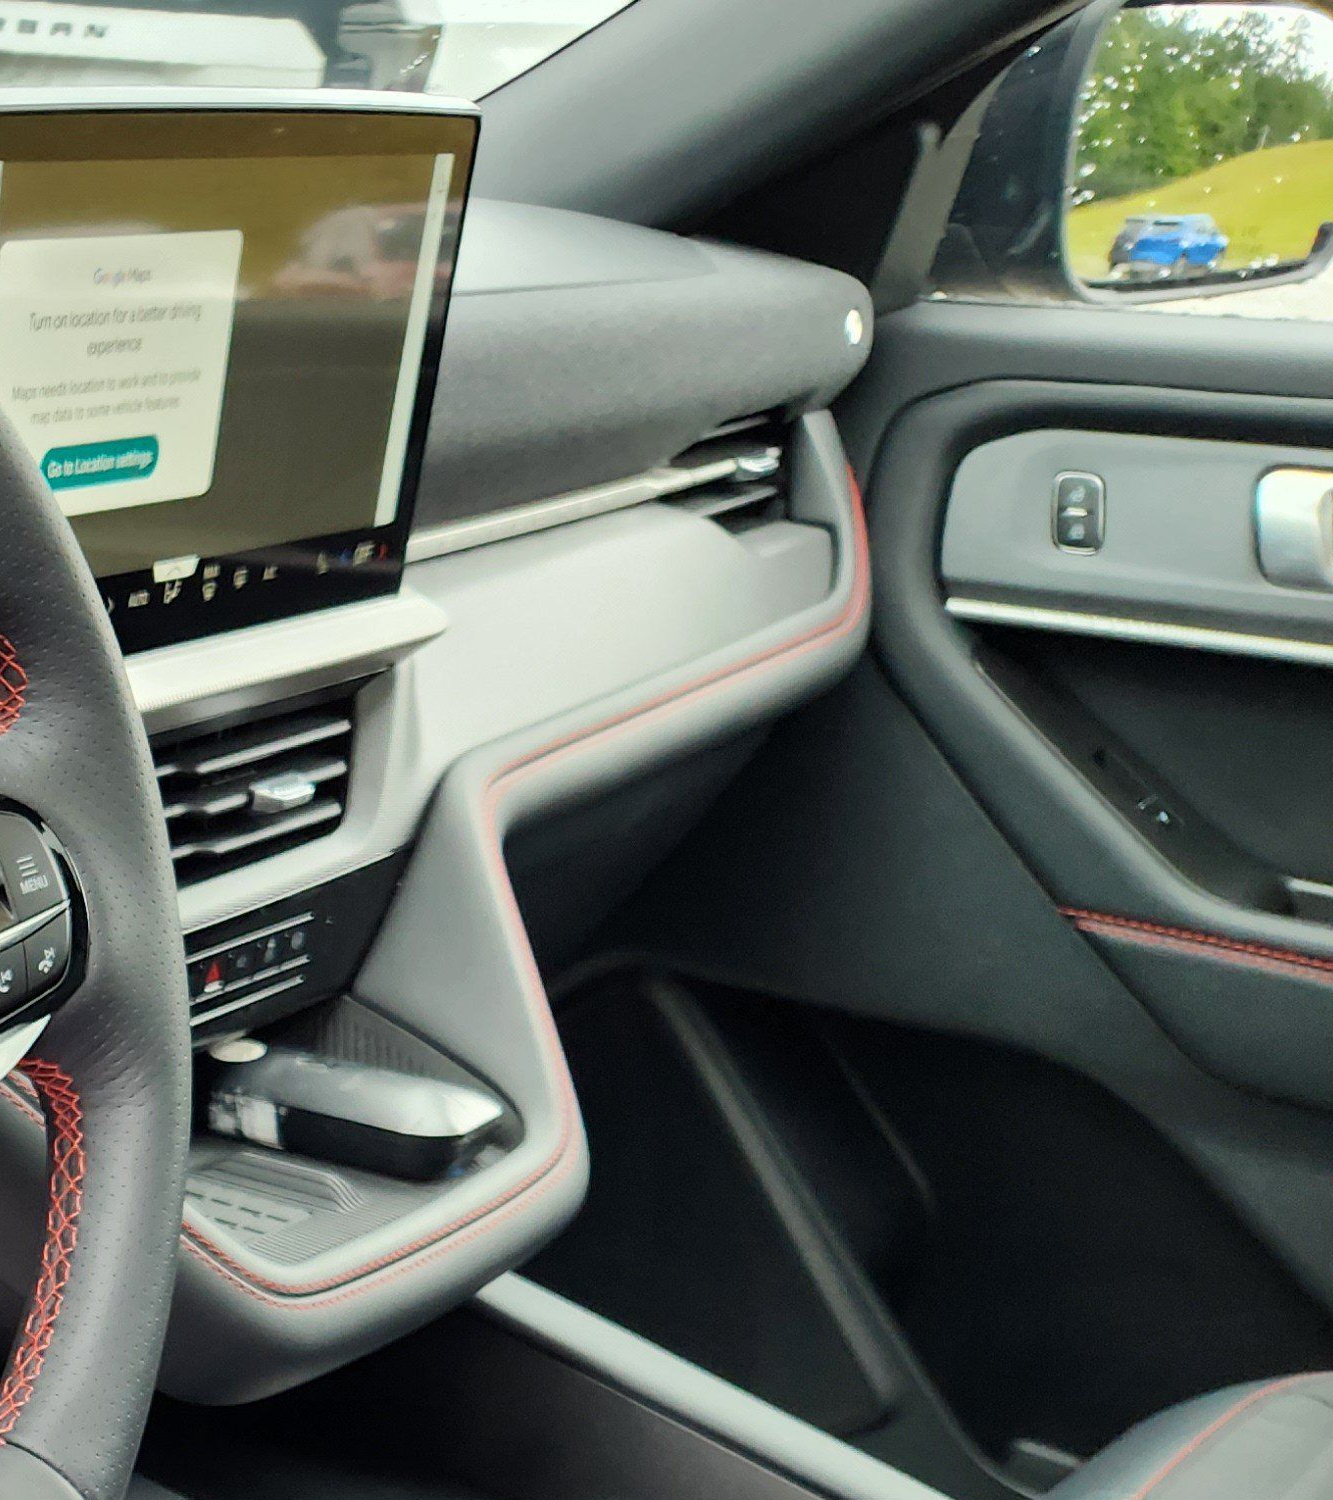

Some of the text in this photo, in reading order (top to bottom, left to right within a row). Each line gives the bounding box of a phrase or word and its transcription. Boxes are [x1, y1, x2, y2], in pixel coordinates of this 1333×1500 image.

[29, 311, 52, 331] Turn
[53, 314, 68, 329] on
[69, 308, 111, 328] location
[113, 307, 128, 323] for
[47, 448, 154, 479] Go to Location settings
[19, 874, 49, 895] MENU
